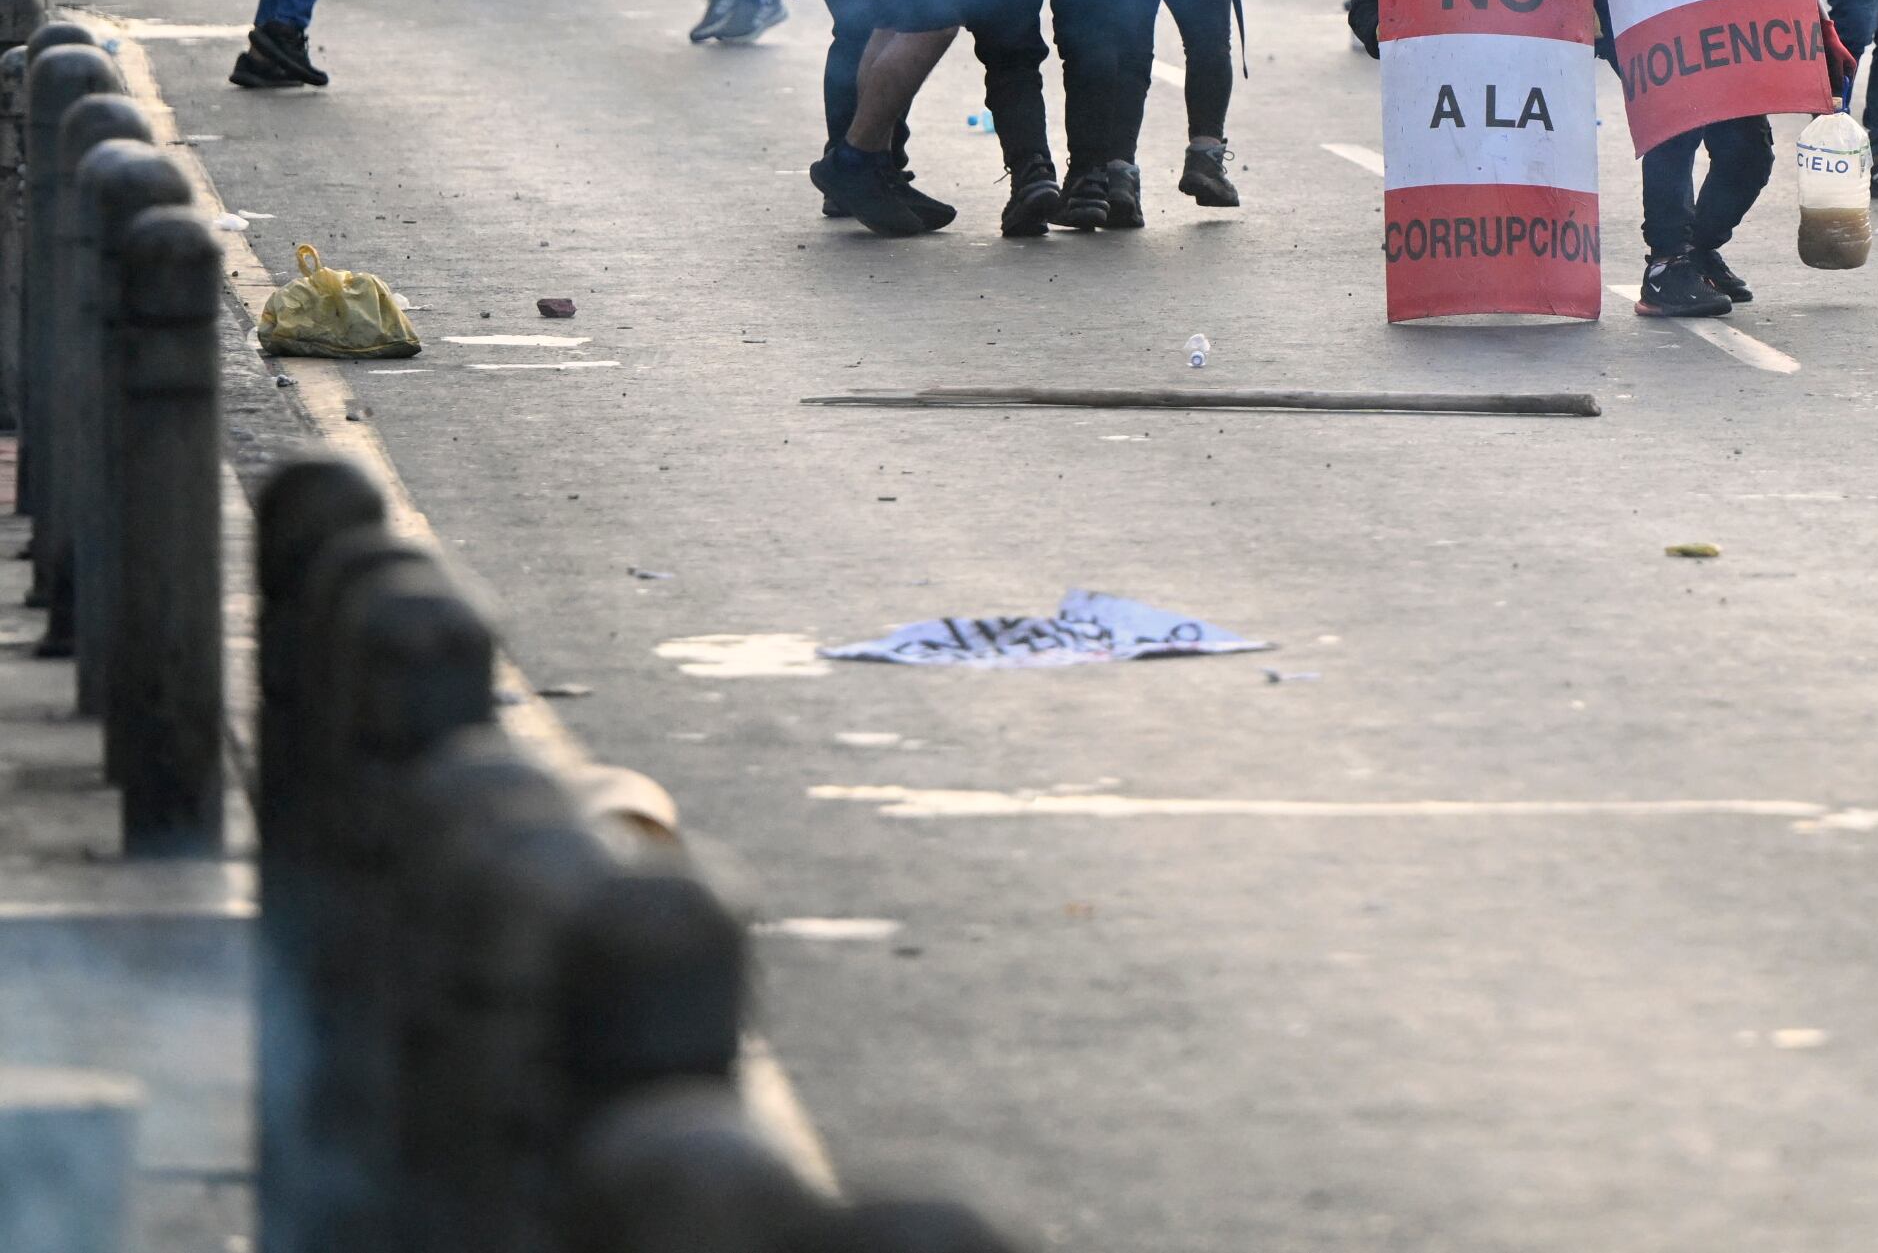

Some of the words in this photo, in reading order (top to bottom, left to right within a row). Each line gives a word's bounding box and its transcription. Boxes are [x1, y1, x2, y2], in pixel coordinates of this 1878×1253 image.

[1619, 18, 1826, 103] VIOLENCIA
[1429, 84, 1466, 129] A
[1485, 84, 1555, 132] LA
[1796, 152, 1849, 174] CIELO
[1385, 209, 1601, 264] CORRUPCIÓN
